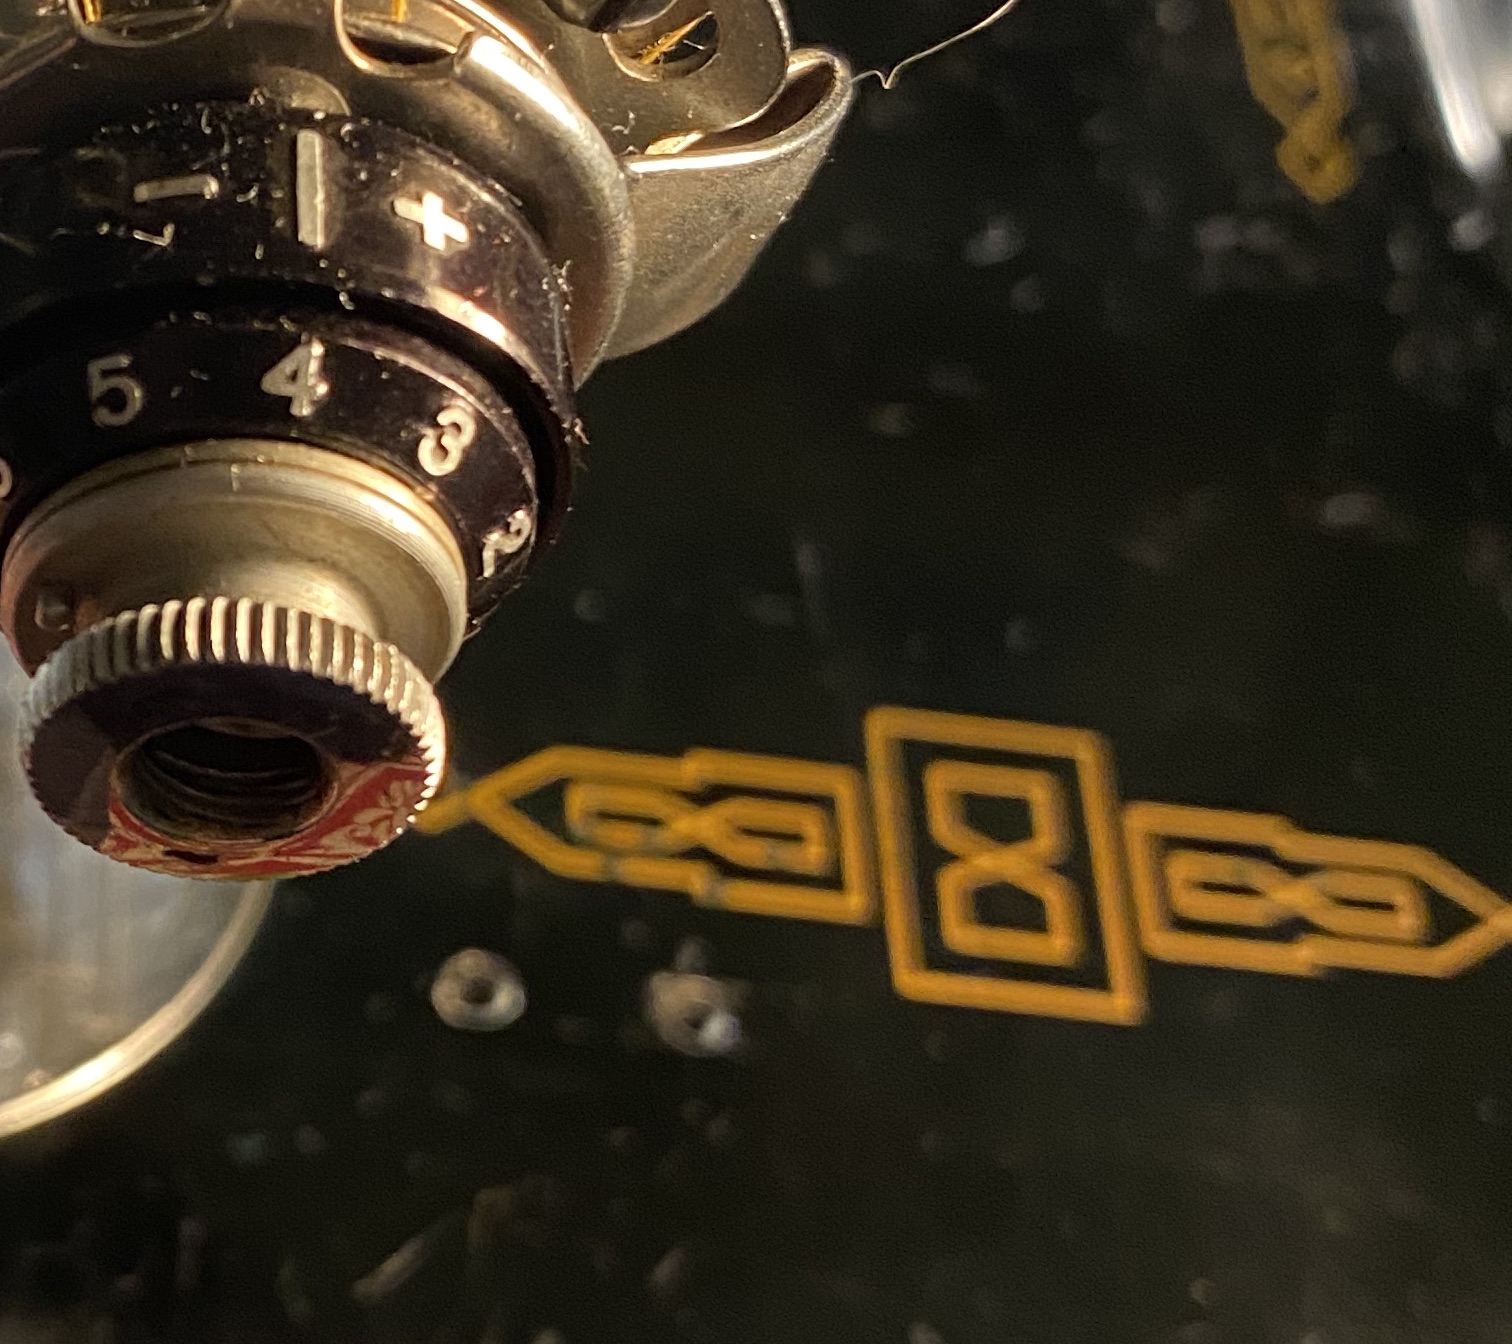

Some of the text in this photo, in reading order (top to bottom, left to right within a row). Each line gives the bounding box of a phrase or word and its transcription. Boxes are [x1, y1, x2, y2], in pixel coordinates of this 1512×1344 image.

[86, 357, 144, 427] 5
[262, 337, 329, 416] 4
[418, 406, 475, 475] 3
[481, 509, 530, 577] 2
